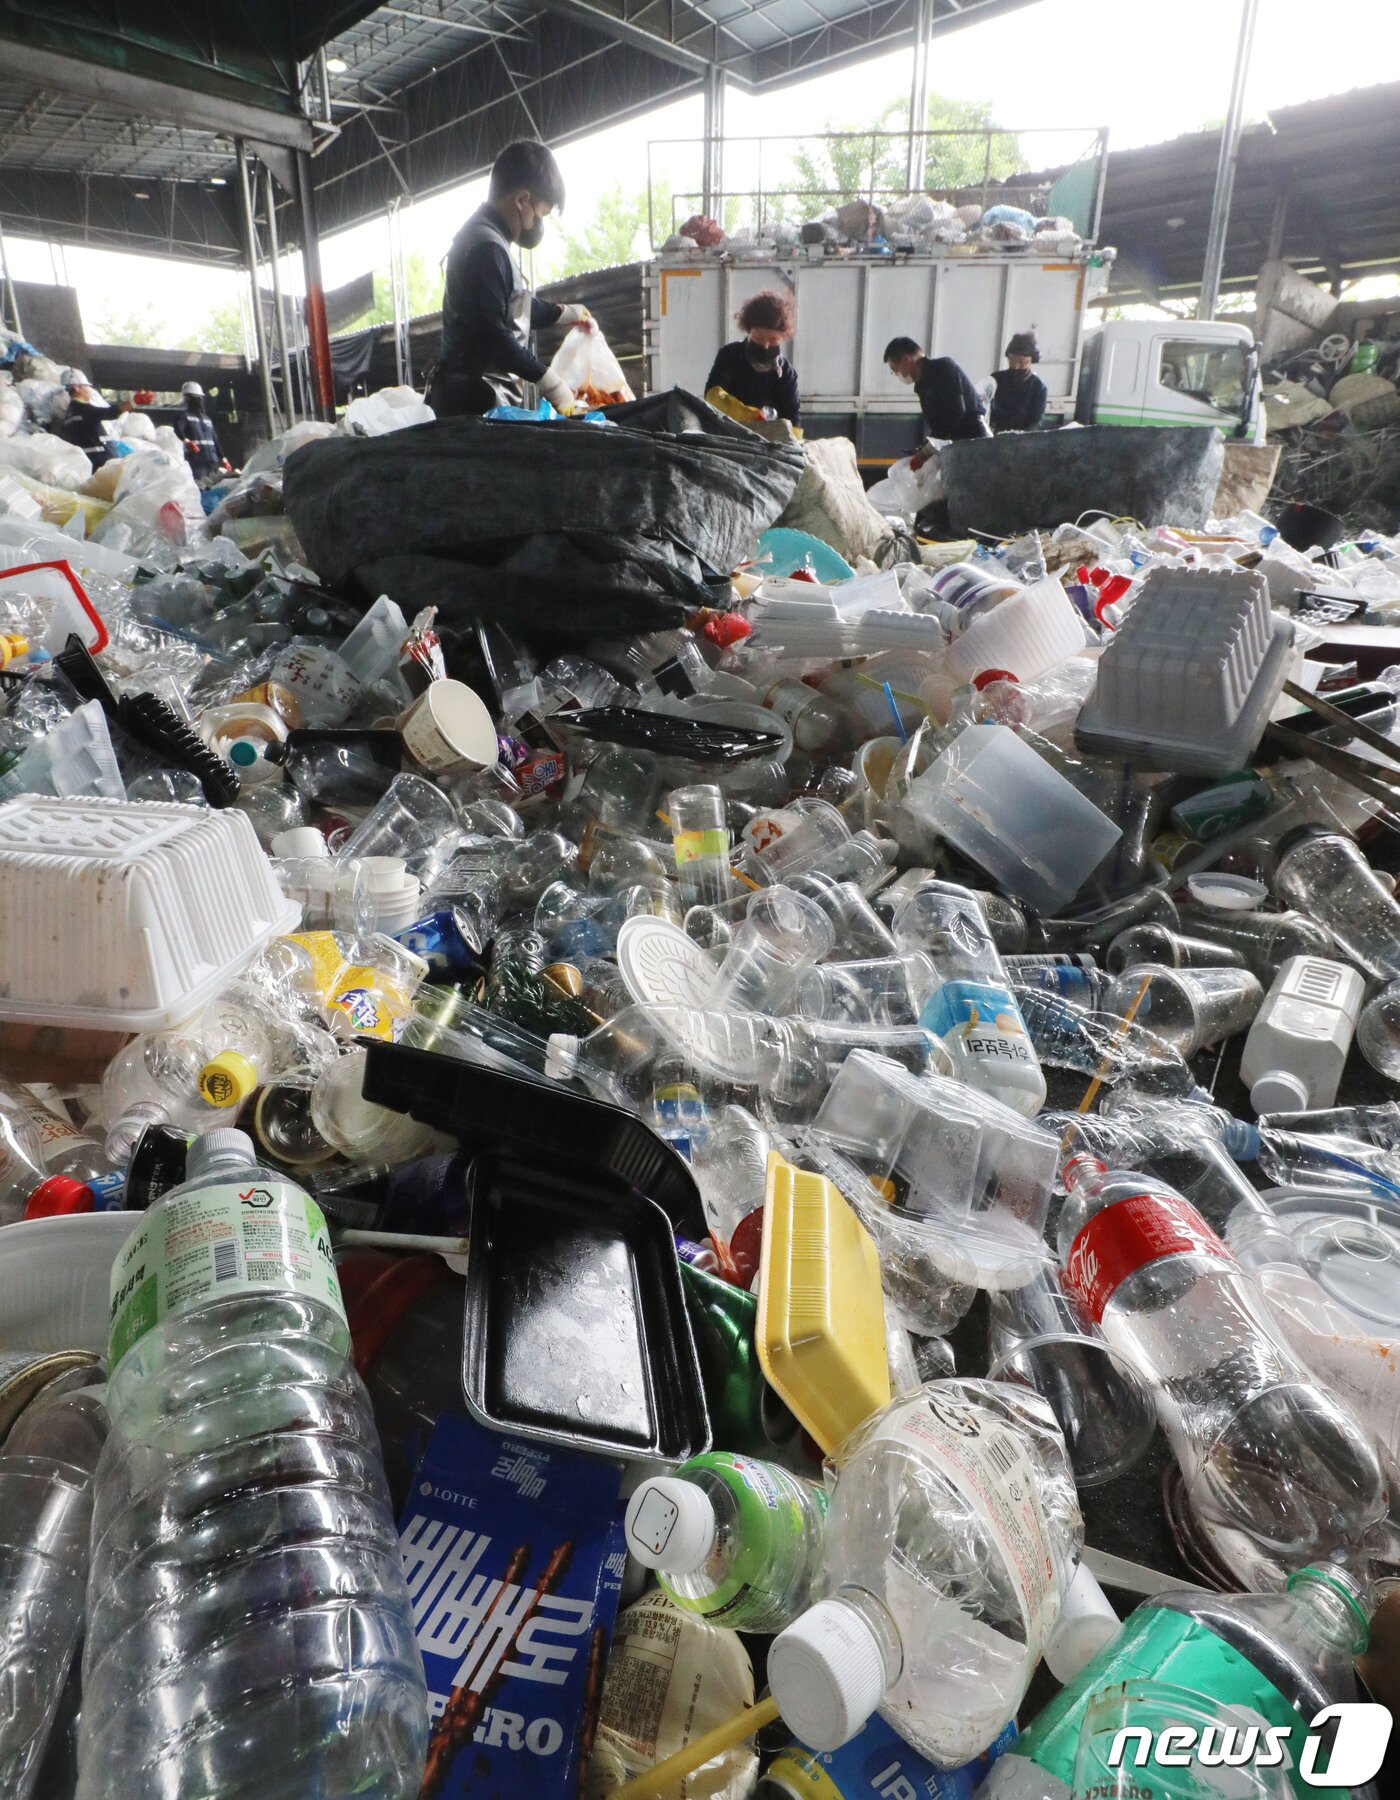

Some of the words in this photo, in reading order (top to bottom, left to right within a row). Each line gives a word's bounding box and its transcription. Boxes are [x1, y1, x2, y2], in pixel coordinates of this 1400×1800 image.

[966, 1039, 1030, 1060] 하늘보리
[213, 1073, 228, 1102] FANTA
[501, 1441, 551, 1463] PEPERO
[490, 1456, 548, 1499] 빼빼로
[434, 1486, 479, 1510] LOTTE
[399, 1514, 596, 1694] 빼빼로
